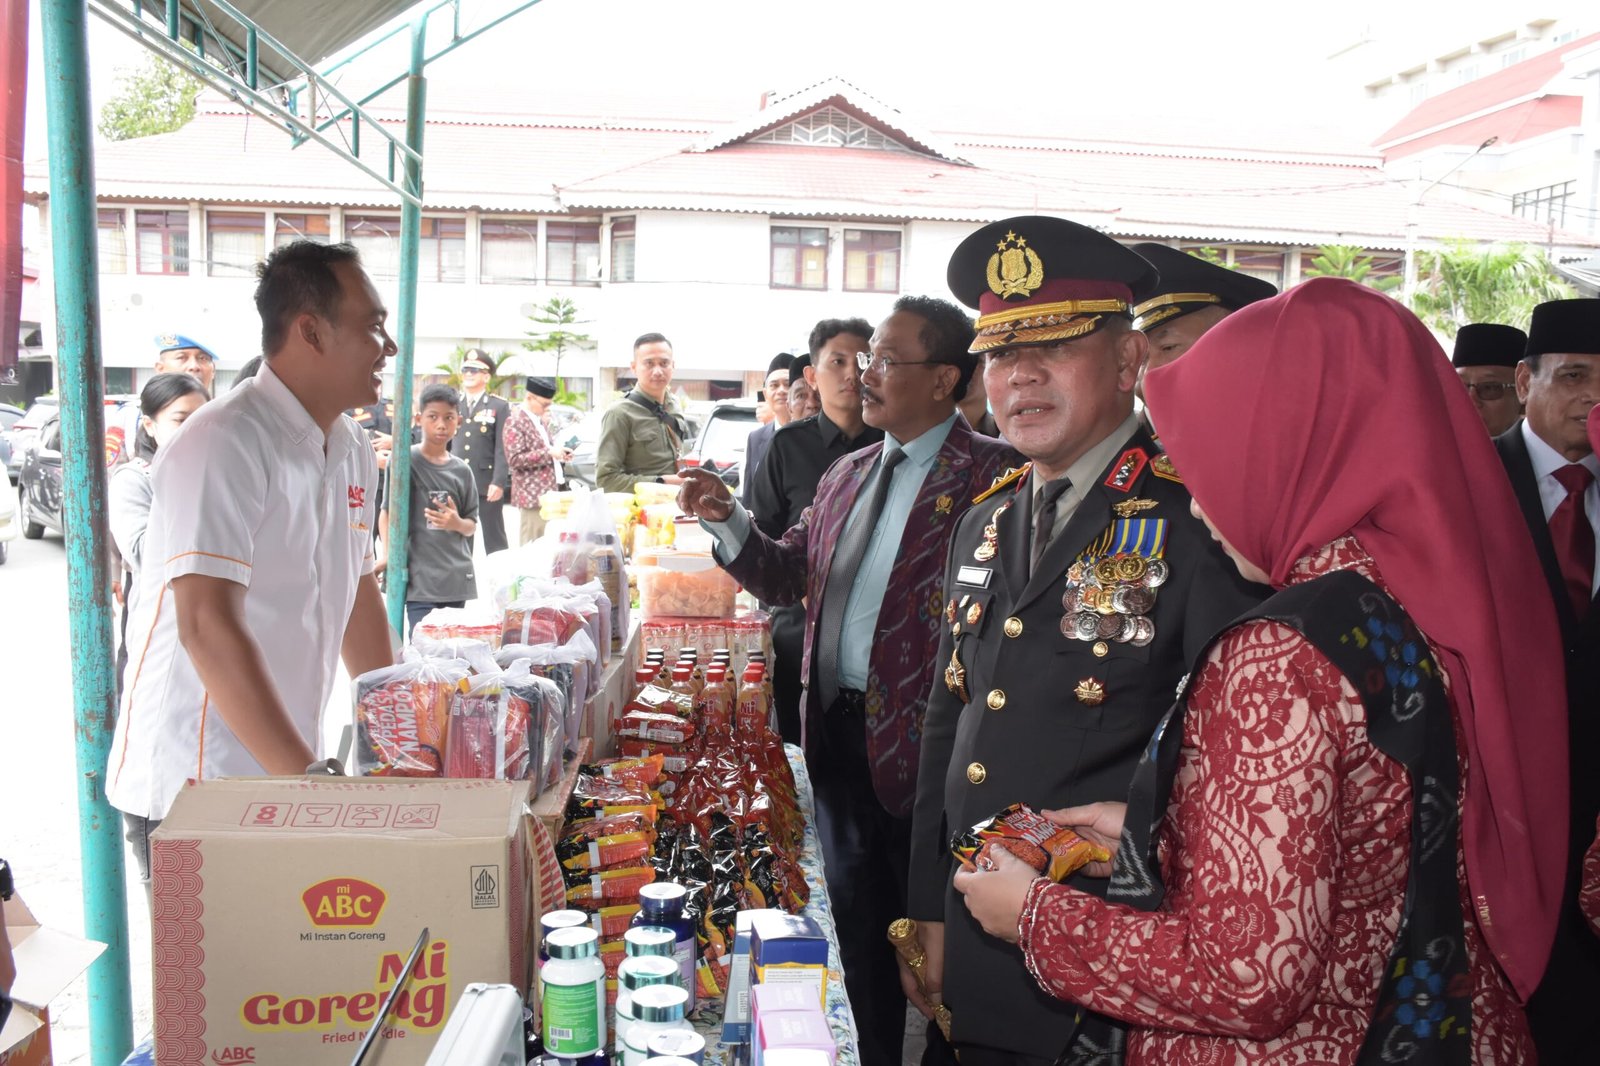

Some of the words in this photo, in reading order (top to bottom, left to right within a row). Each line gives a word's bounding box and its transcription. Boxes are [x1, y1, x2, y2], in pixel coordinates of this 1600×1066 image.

[378, 692, 398, 739] PEDAS
[256, 806, 278, 821] 8
[336, 884, 350, 894] mi
[316, 895, 372, 918] ABC
[300, 933, 313, 942] Mi
[314, 932, 347, 941] Instan
[348, 931, 386, 942] Goreng
[379, 942, 446, 983] Mi
[243, 983, 446, 1028] Goreng
[322, 1031, 356, 1044] Fried
[359, 1027, 406, 1041] Ndle
[221, 1046, 256, 1060] ABC
